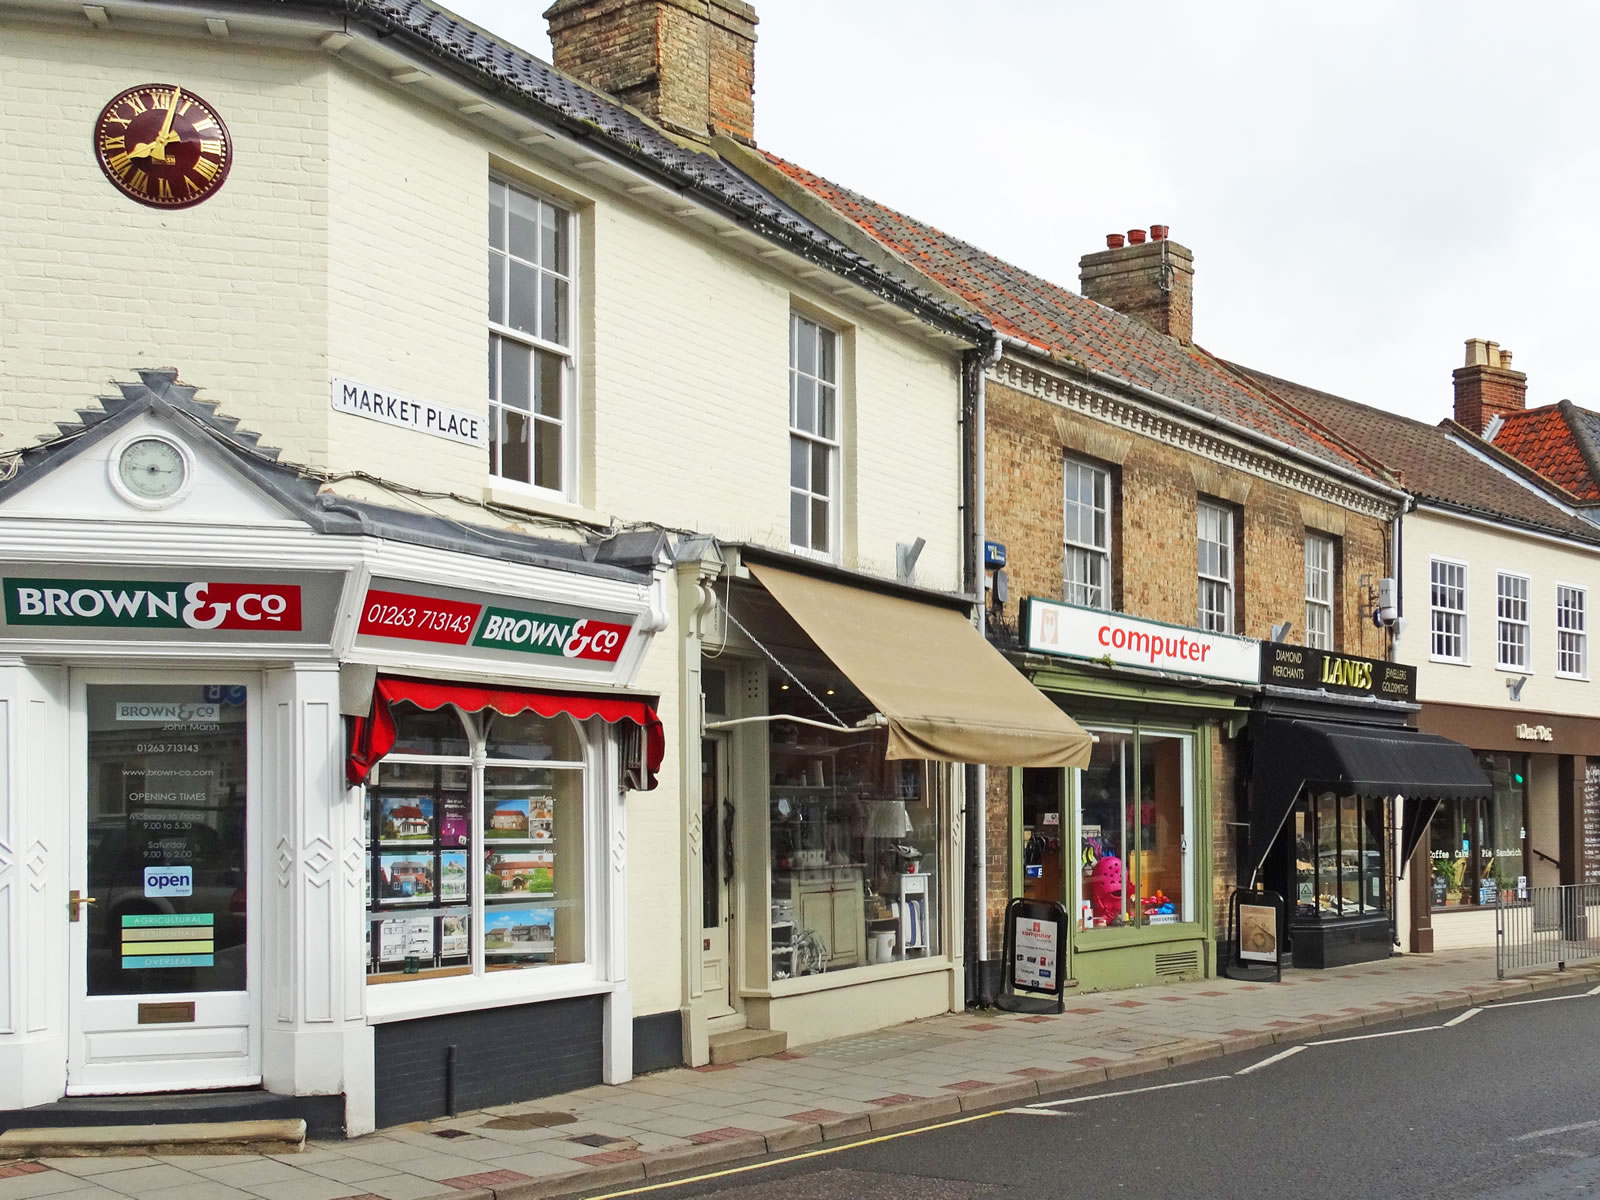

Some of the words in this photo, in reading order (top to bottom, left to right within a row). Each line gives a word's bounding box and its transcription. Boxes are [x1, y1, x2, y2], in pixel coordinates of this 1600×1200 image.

[343, 384, 421, 425] MARKET
[427, 408, 478, 440] PLACE
[17, 587, 178, 619] BROWN
[367, 603, 417, 628] 01263
[417, 609, 471, 633] 713143
[482, 615, 570, 648] BROWN
[1098, 625, 1211, 663] computer
[1276, 649, 1303, 664] DIAMOND
[1272, 665, 1305, 680] MERCHANTS
[1321, 655, 1373, 690] LANES
[1385, 667, 1407, 681] JEWELLERS
[1382, 681, 1409, 695] GOLDSMITHS
[120, 706, 176, 717] BROWN
[162, 723, 187, 731] John
[190, 723, 220, 731] Marsh
[136, 744, 165, 752] 01263
[167, 744, 199, 752] 713143
[122, 769, 214, 777] www.brown-co.com
[129, 793, 177, 801] OPENING
[179, 793, 206, 801] TIMES
[163, 822, 172, 830] to
[148, 841, 187, 850] Saturday
[147, 875, 190, 889] open
[134, 917, 202, 925] AGRICULTURAL
[144, 957, 192, 966] OVERSEAS
